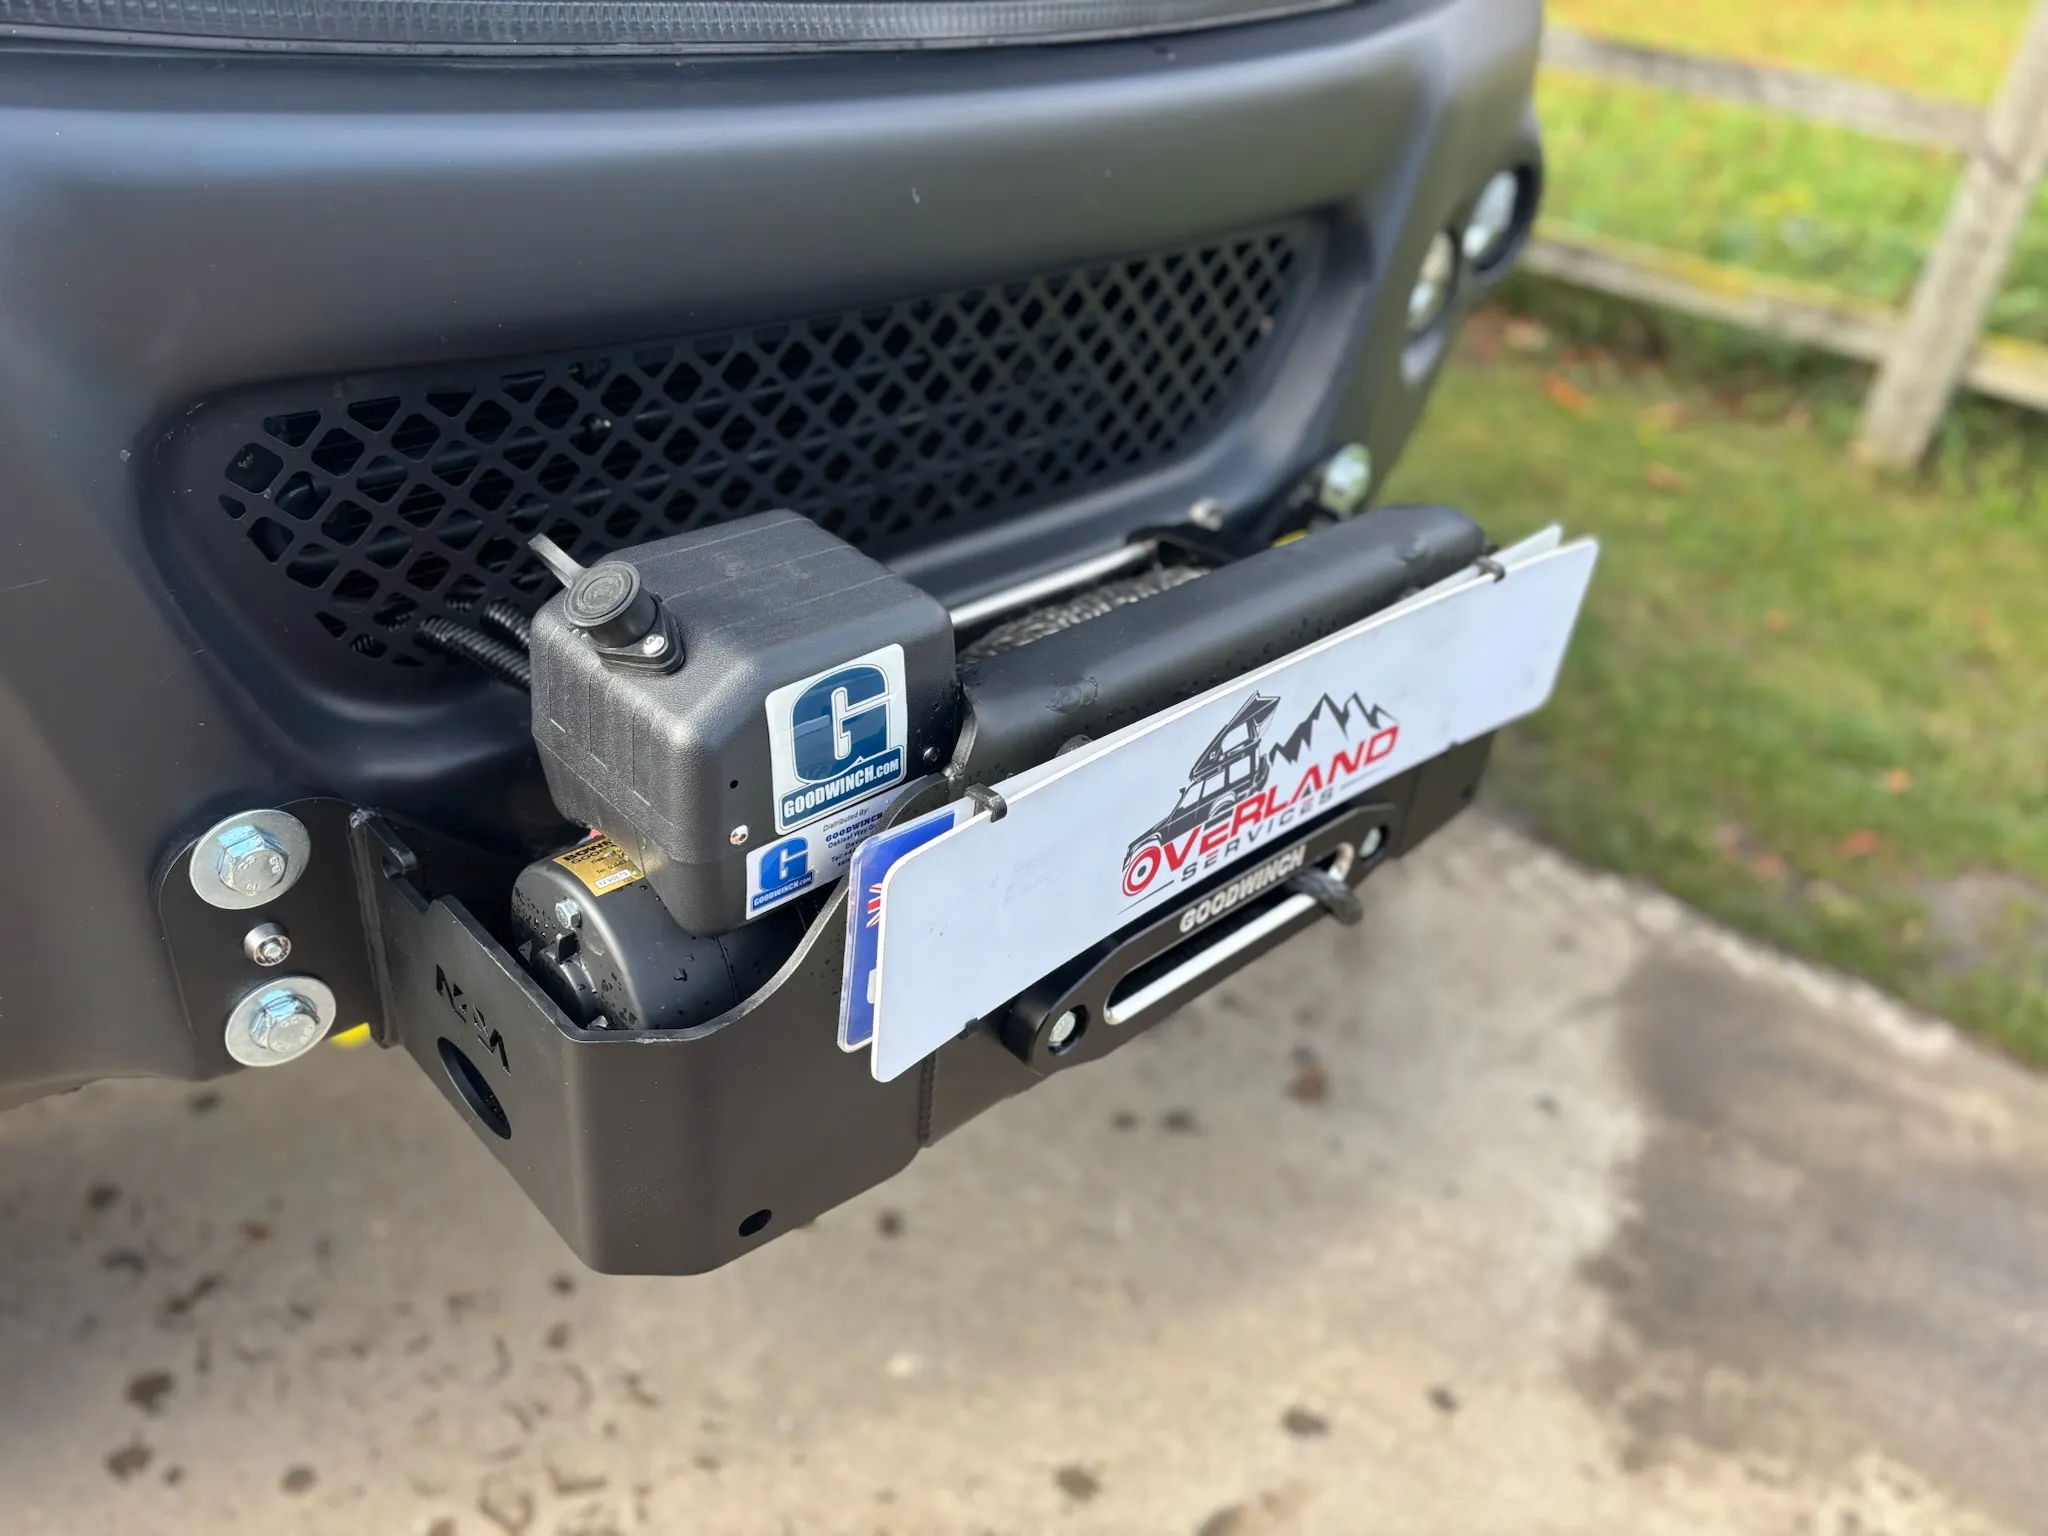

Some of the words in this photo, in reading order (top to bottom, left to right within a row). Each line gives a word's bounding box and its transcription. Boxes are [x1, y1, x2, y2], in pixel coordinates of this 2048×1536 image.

[823, 810, 858, 832] Distributed
[825, 811, 883, 842] GOODWINCH
[1122, 725, 1399, 896] OVERLAND
[1181, 785, 1334, 882] SERVICES
[1179, 844, 1307, 933] GOODWINCH
